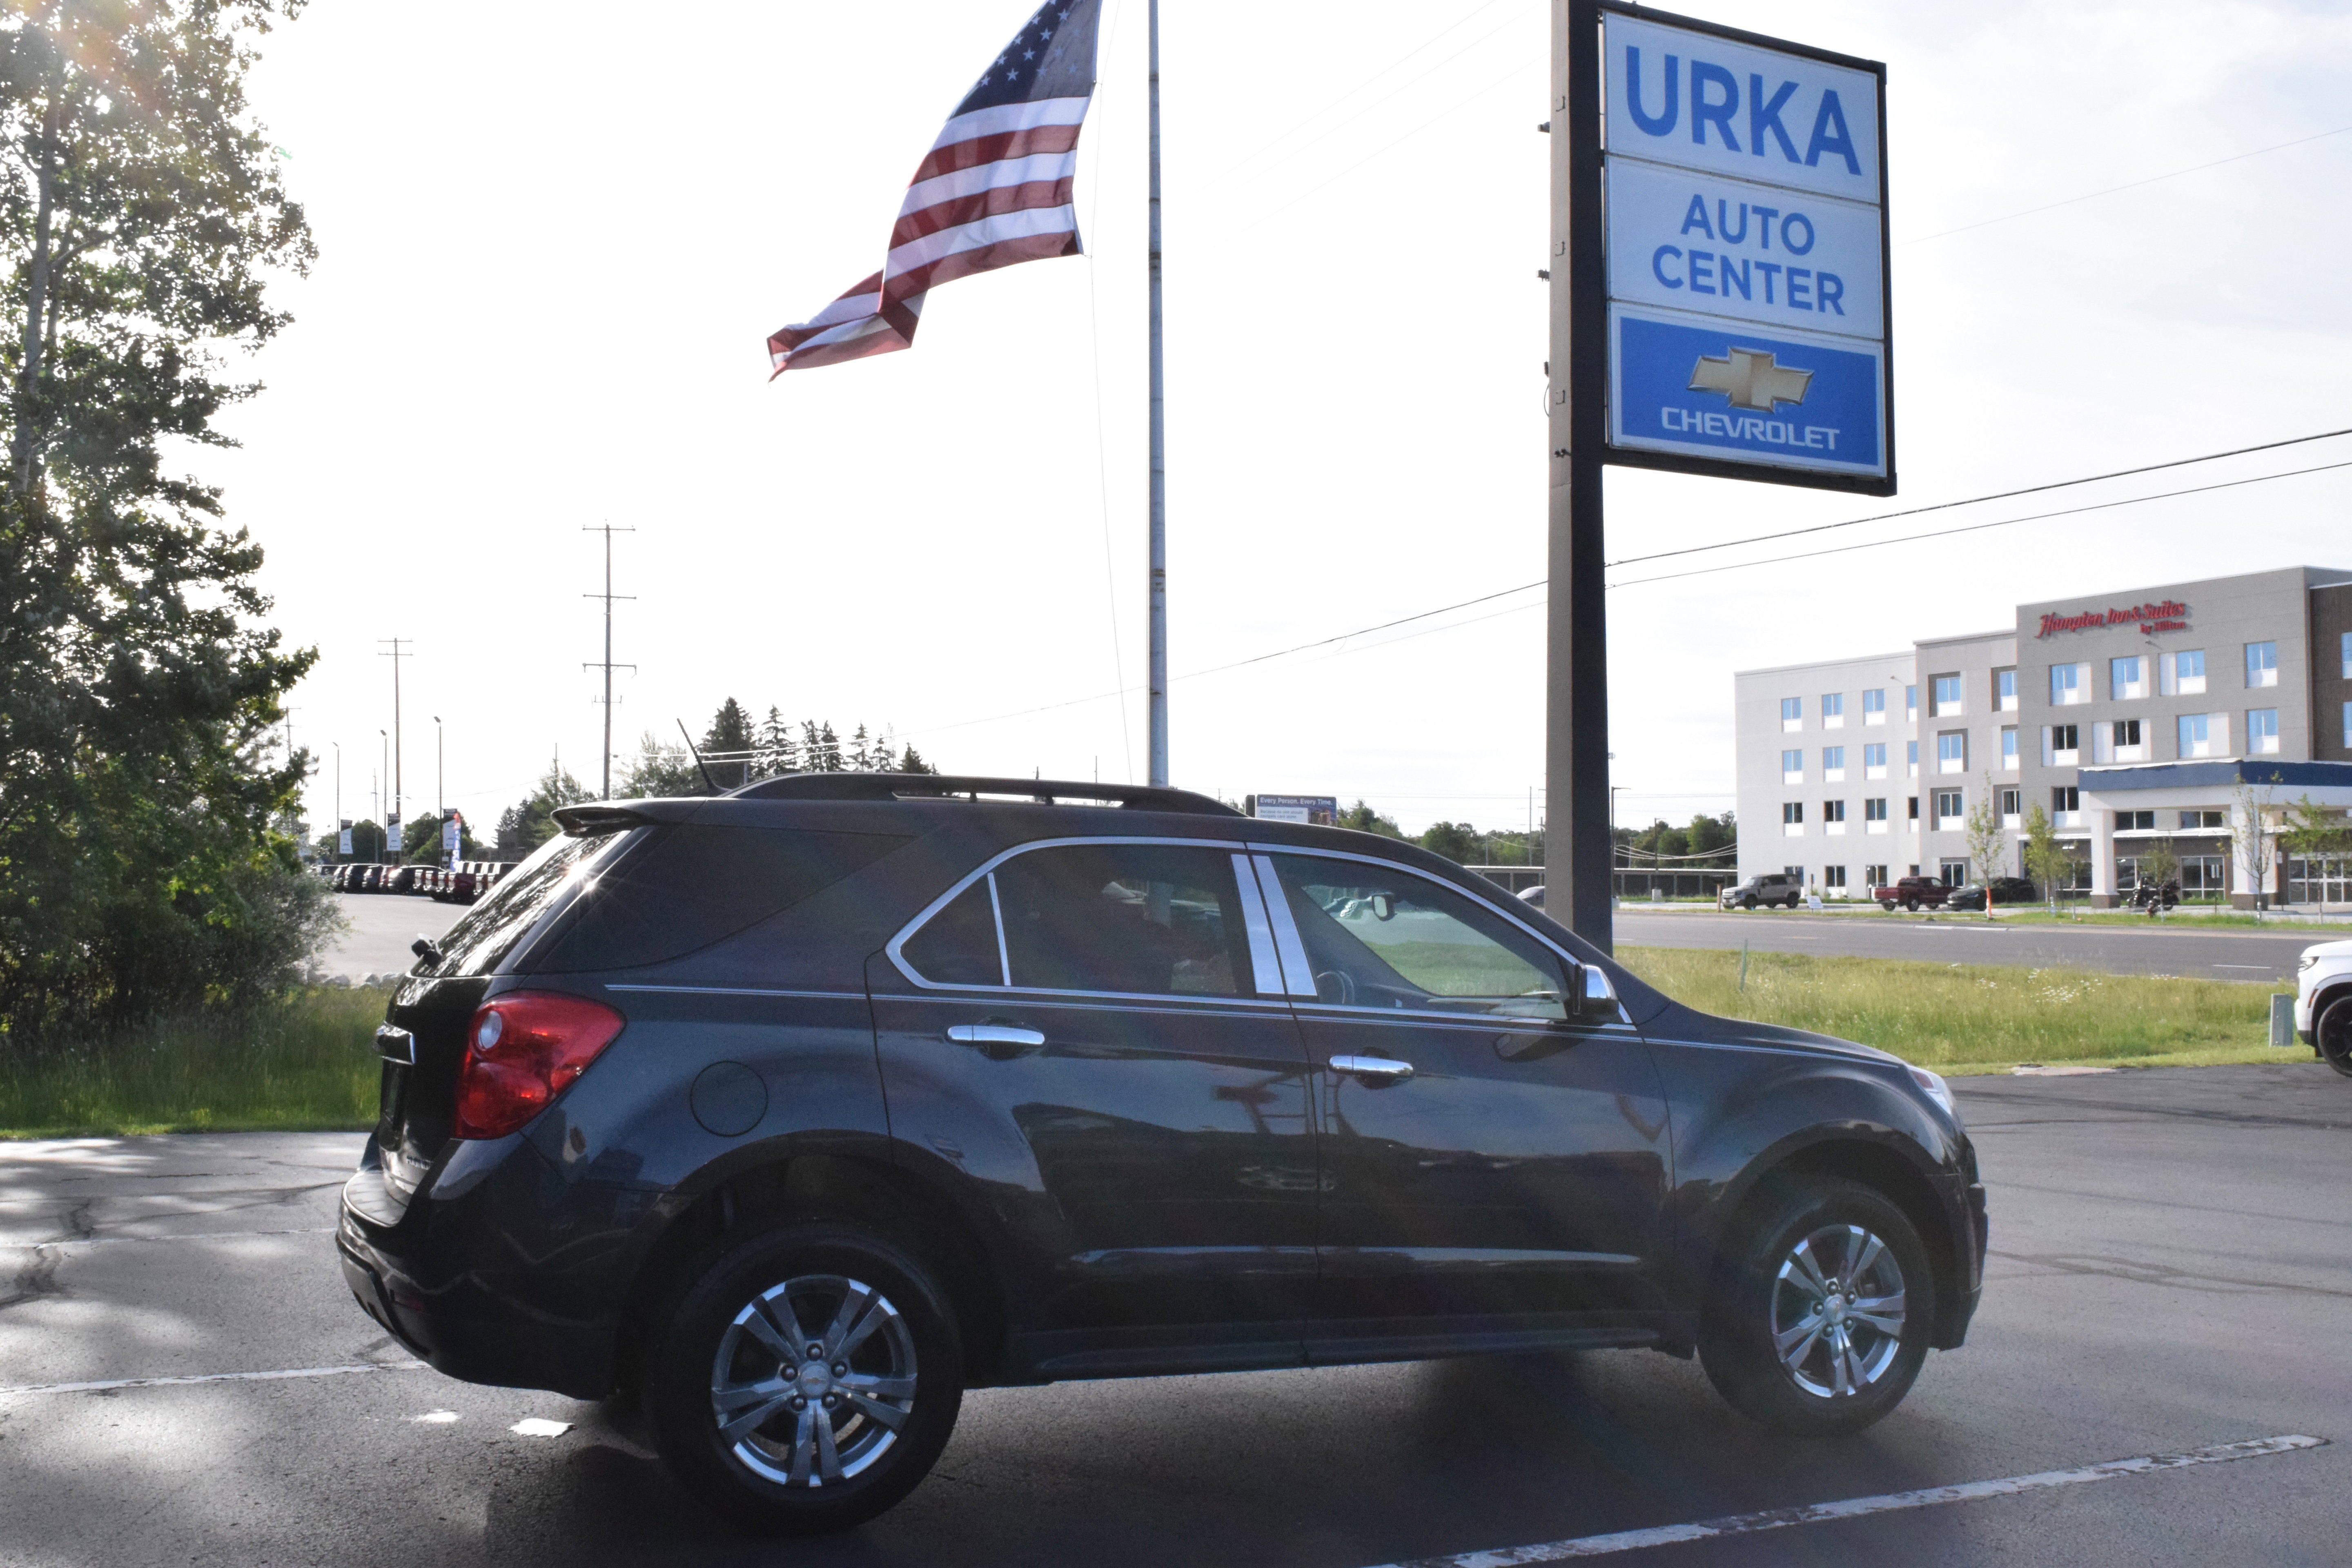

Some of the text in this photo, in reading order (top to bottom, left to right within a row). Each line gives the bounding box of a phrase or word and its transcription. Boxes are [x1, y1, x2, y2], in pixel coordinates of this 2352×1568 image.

[1626, 45, 1862, 176] URKA
[1680, 194, 1815, 256] AUTO
[1652, 245, 1845, 316] CENTER
[1662, 407, 1840, 450] CHEVROLET
[2035, 600, 2185, 638] Hampton Inn & Suites
[2139, 620, 2185, 635] by Hilton
